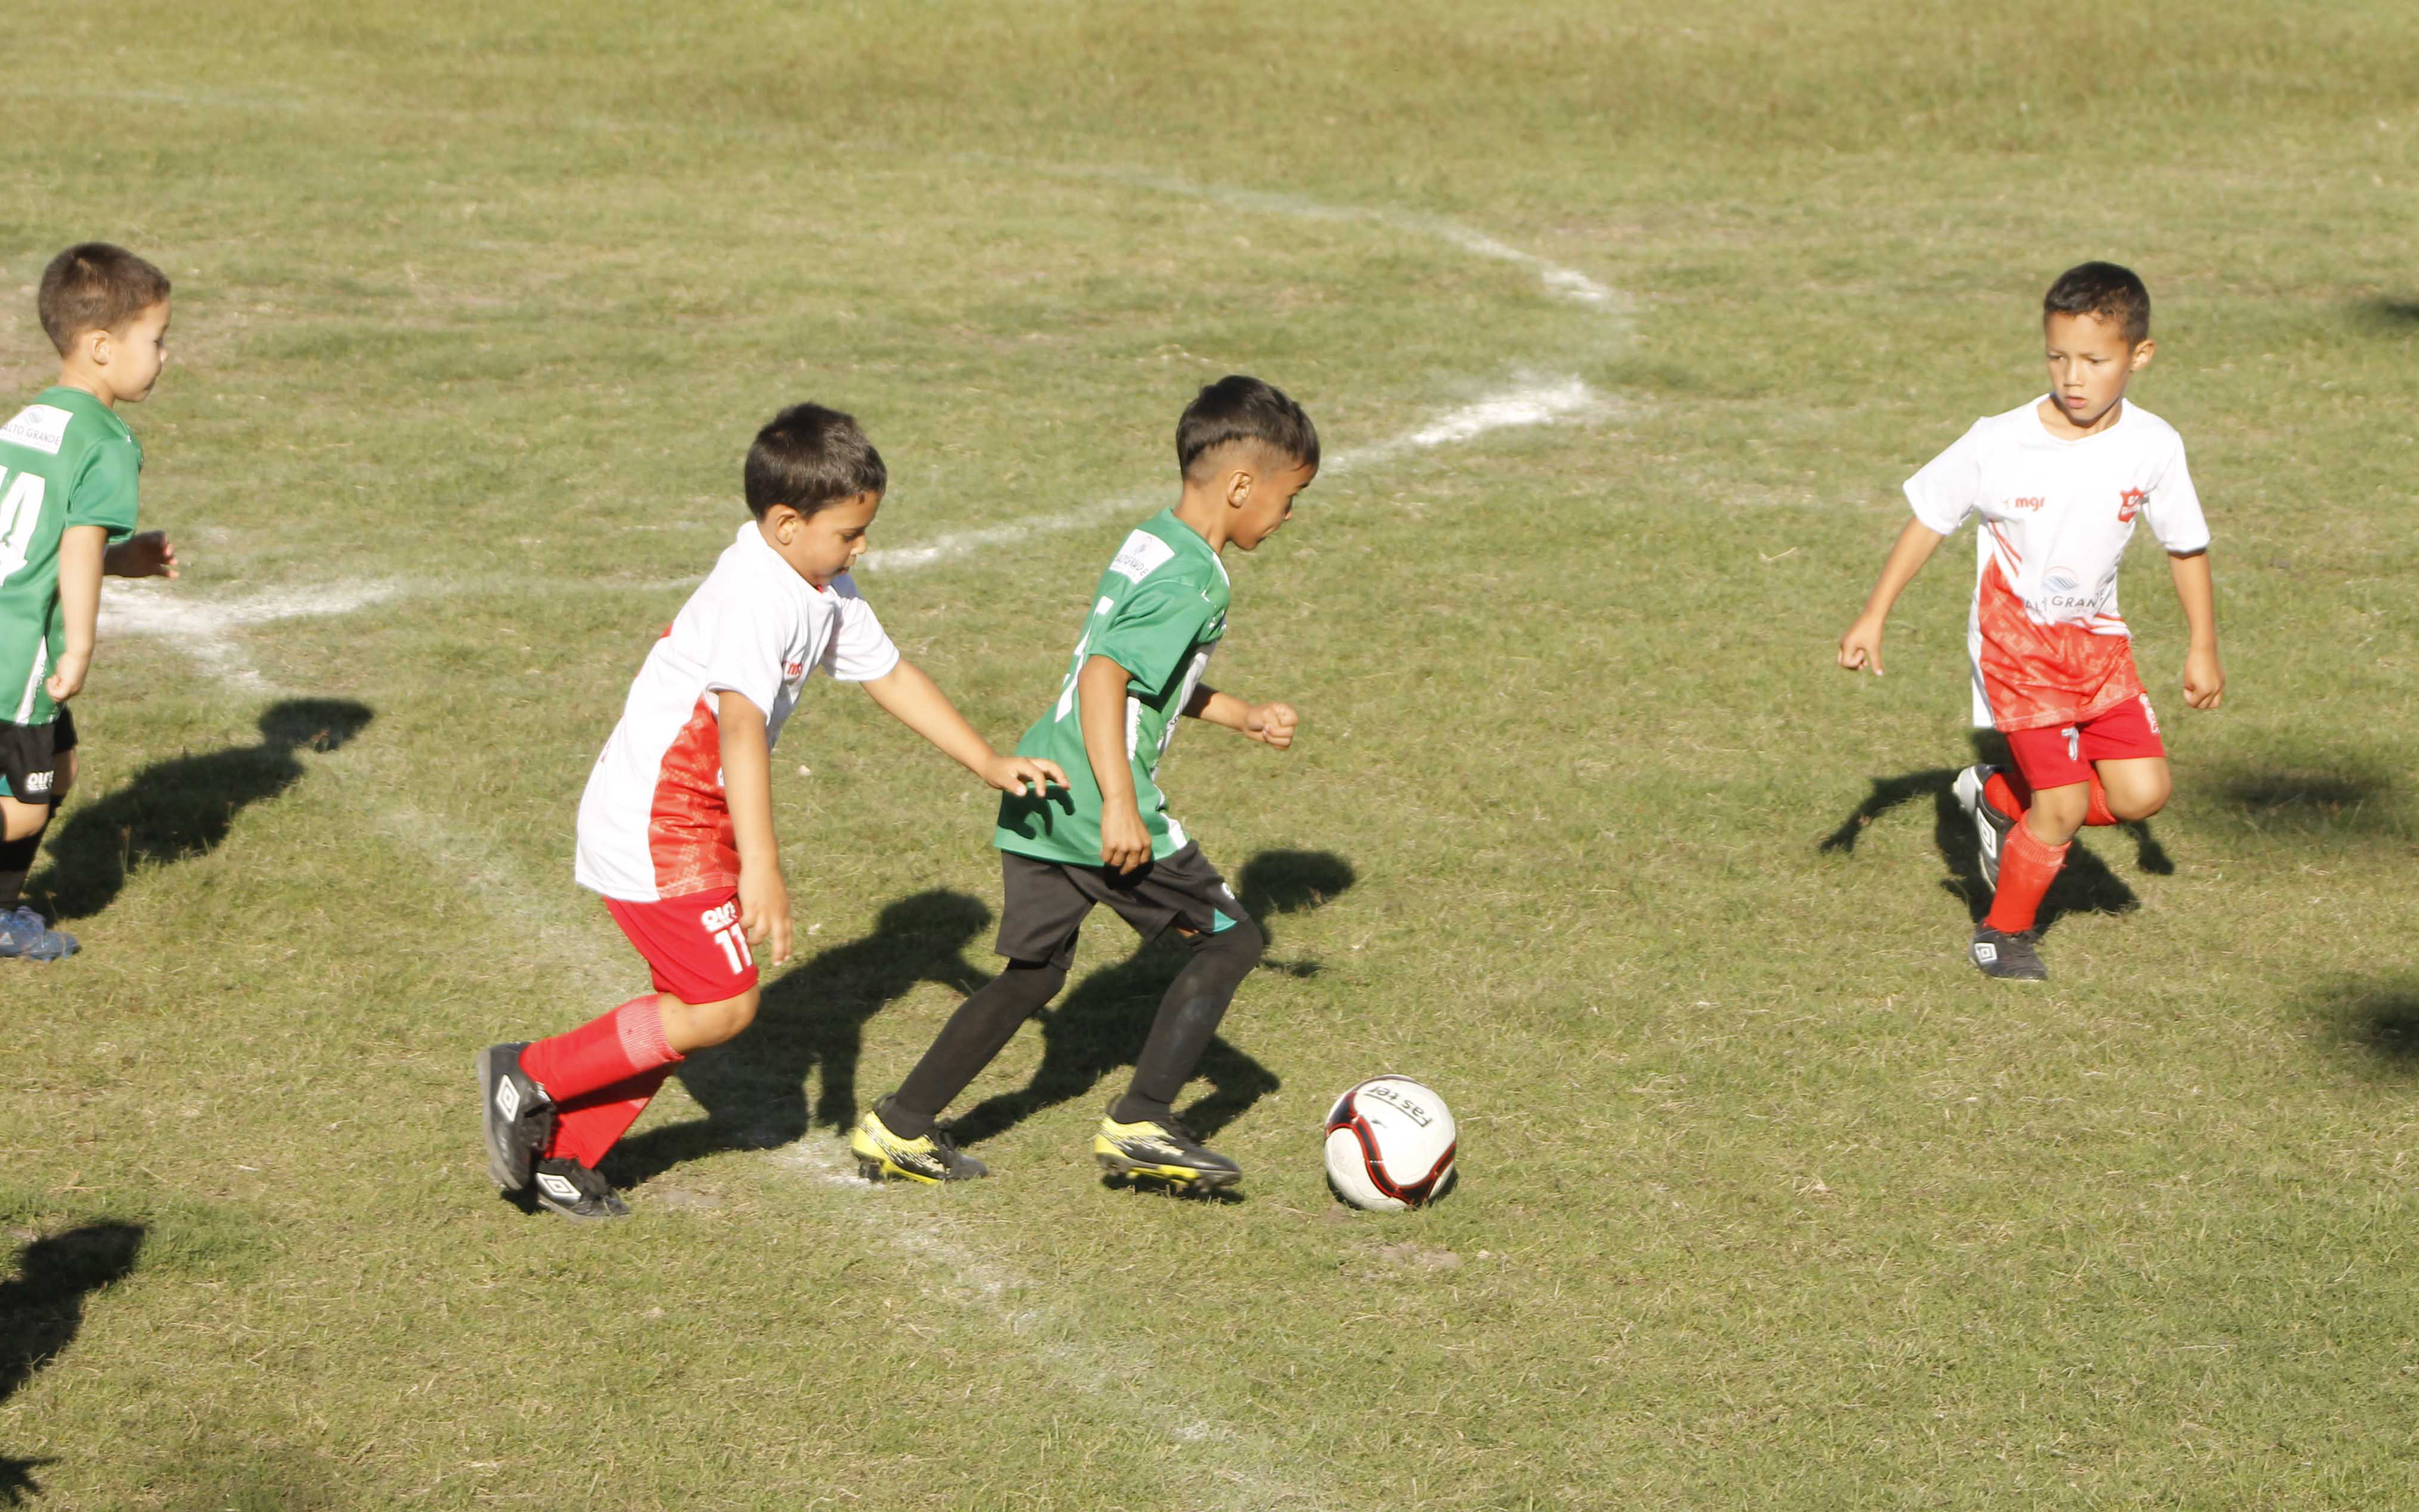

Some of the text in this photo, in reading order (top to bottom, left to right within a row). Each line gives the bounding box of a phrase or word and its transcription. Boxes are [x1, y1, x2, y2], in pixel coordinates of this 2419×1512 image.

[26, 428, 61, 446] GRANDE
[714, 922, 753, 975] 11
[1364, 1086, 1434, 1128] Faster
